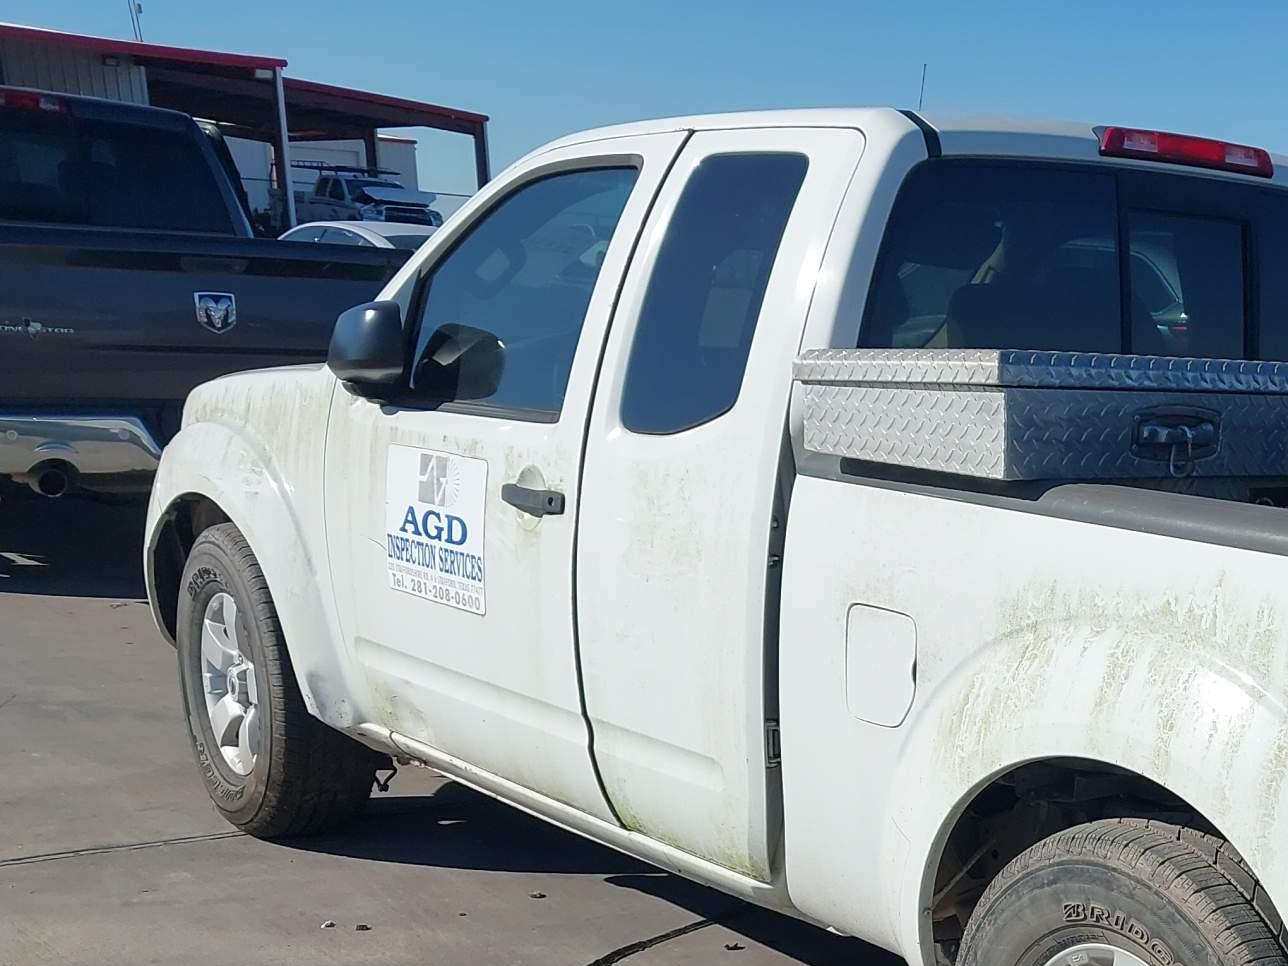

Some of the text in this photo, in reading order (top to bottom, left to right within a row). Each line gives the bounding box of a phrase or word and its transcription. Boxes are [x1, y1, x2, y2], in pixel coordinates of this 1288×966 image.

[399, 505, 468, 546] AGD
[387, 533, 437, 570] INSPECTION
[438, 546, 483, 583] SERVICES
[391, 572, 408, 590] Tel.
